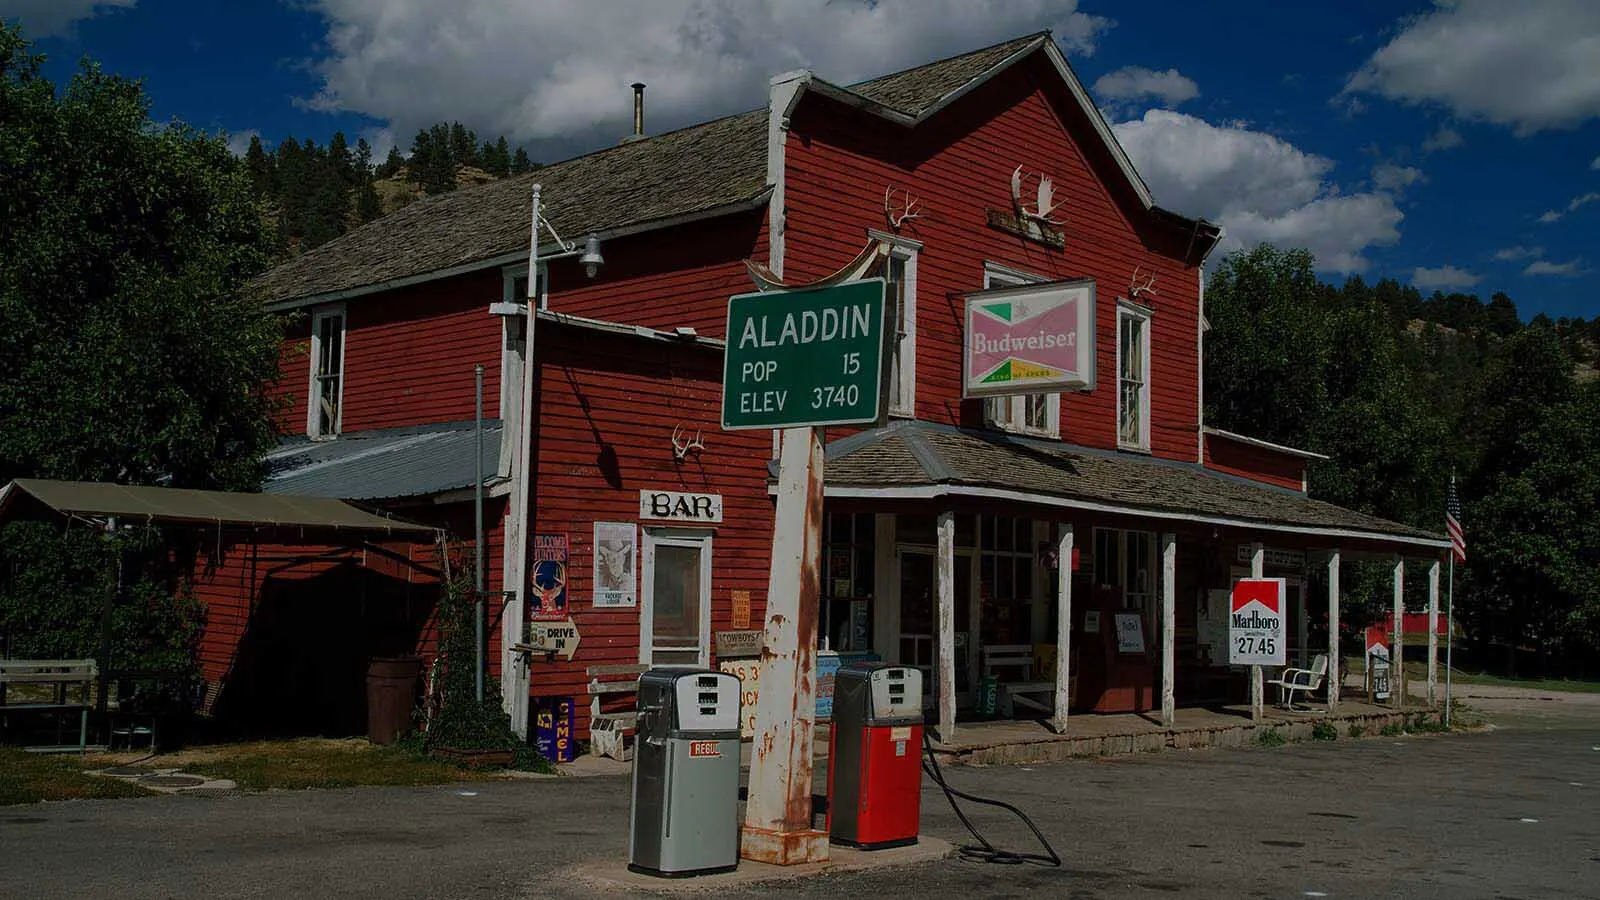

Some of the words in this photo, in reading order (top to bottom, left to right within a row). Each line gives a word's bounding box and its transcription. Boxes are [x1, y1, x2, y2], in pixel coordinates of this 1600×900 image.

[739, 303, 871, 349] ALADDIN
[973, 329, 1076, 355] Budweiser
[742, 360, 778, 383] POP
[842, 352, 861, 375] 15
[740, 390, 788, 413] ELEV
[811, 384, 860, 409] 3740
[651, 493, 714, 519] BAR
[1231, 610, 1279, 629] Marlboro
[547, 628, 575, 638] DRIVE
[555, 639, 565, 649] IN
